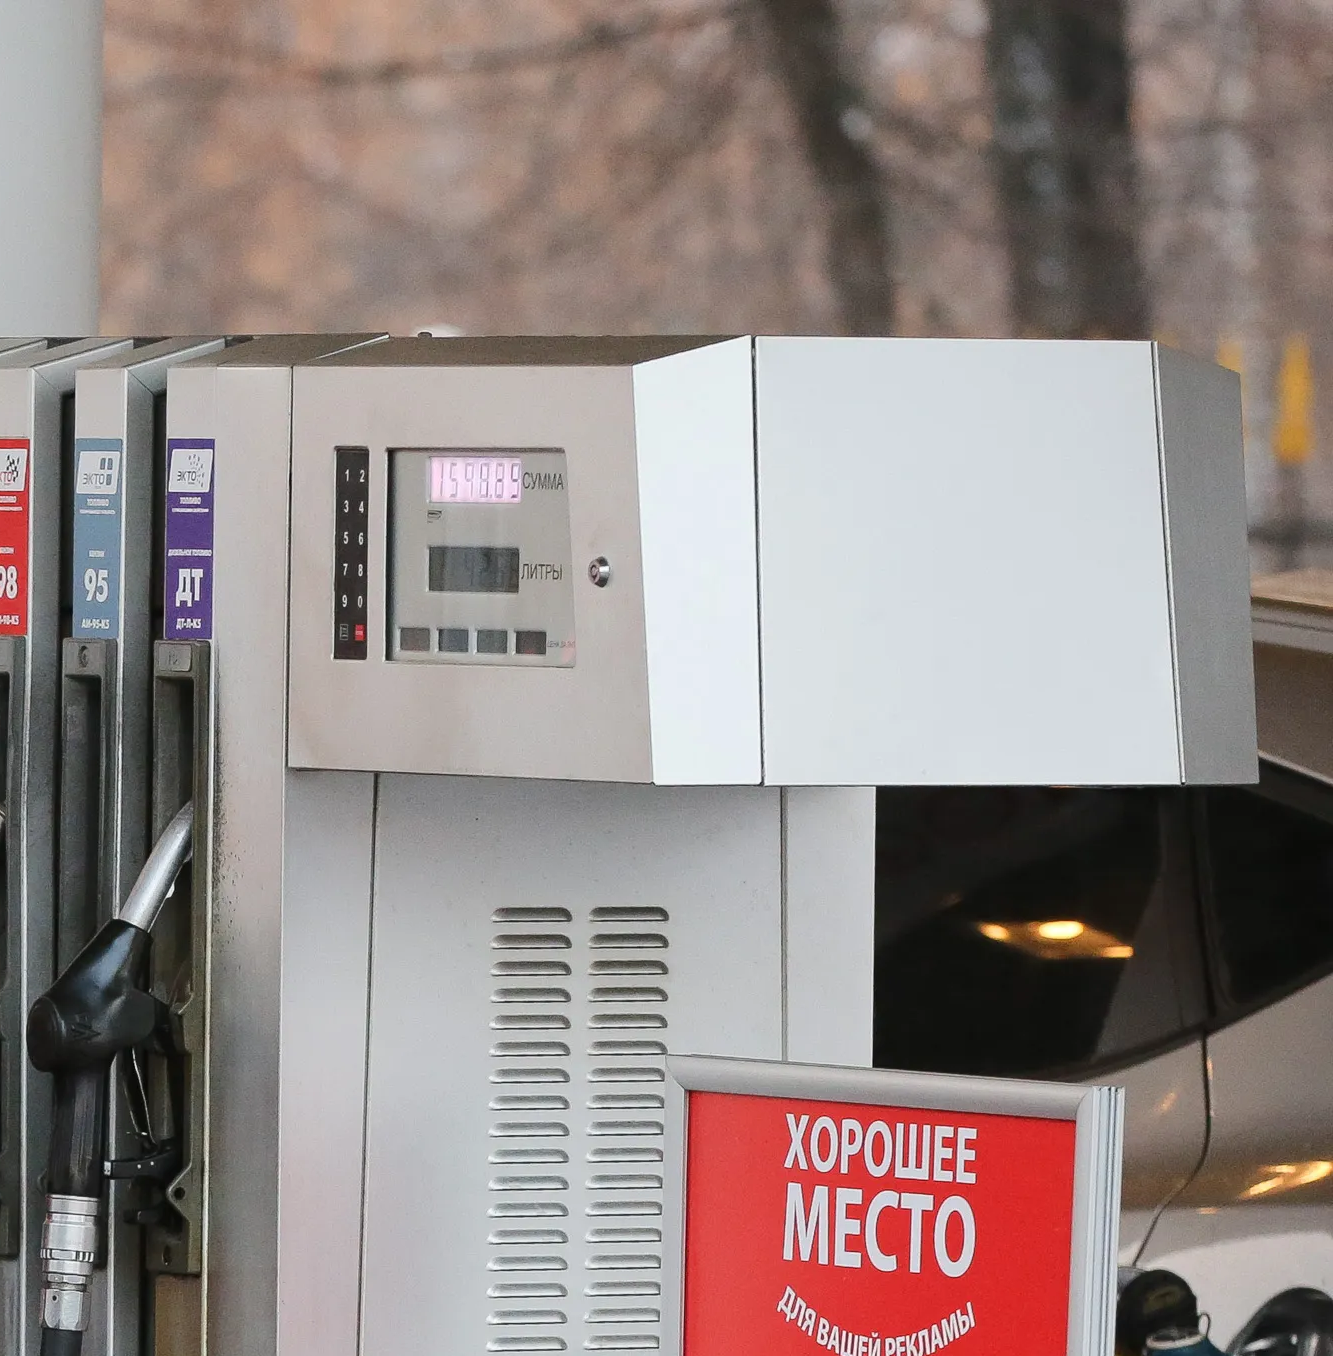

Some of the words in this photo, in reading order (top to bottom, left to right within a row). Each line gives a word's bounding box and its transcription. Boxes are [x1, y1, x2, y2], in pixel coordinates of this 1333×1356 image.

[345, 470, 349, 482] 1
[359, 470, 365, 483] 2
[523, 472, 564, 490] СУММА
[344, 500, 349, 512] 3
[358, 501, 364, 513] 4
[343, 532, 348, 544] 5
[358, 533, 364, 545] 6
[343, 564, 348, 576] 7
[358, 564, 363, 577] 8
[521, 564, 562, 580] ЛИТРЫ
[84, 568, 109, 603] 95
[175, 568, 204, 607] ДТ
[342, 595, 347, 607] 9
[357, 596, 363, 608] 0
[784, 1113, 978, 1185] ХОРОШЕЕ
[782, 1181, 976, 1279] МЕСТО
[776, 1285, 817, 1336] ДЛЯ
